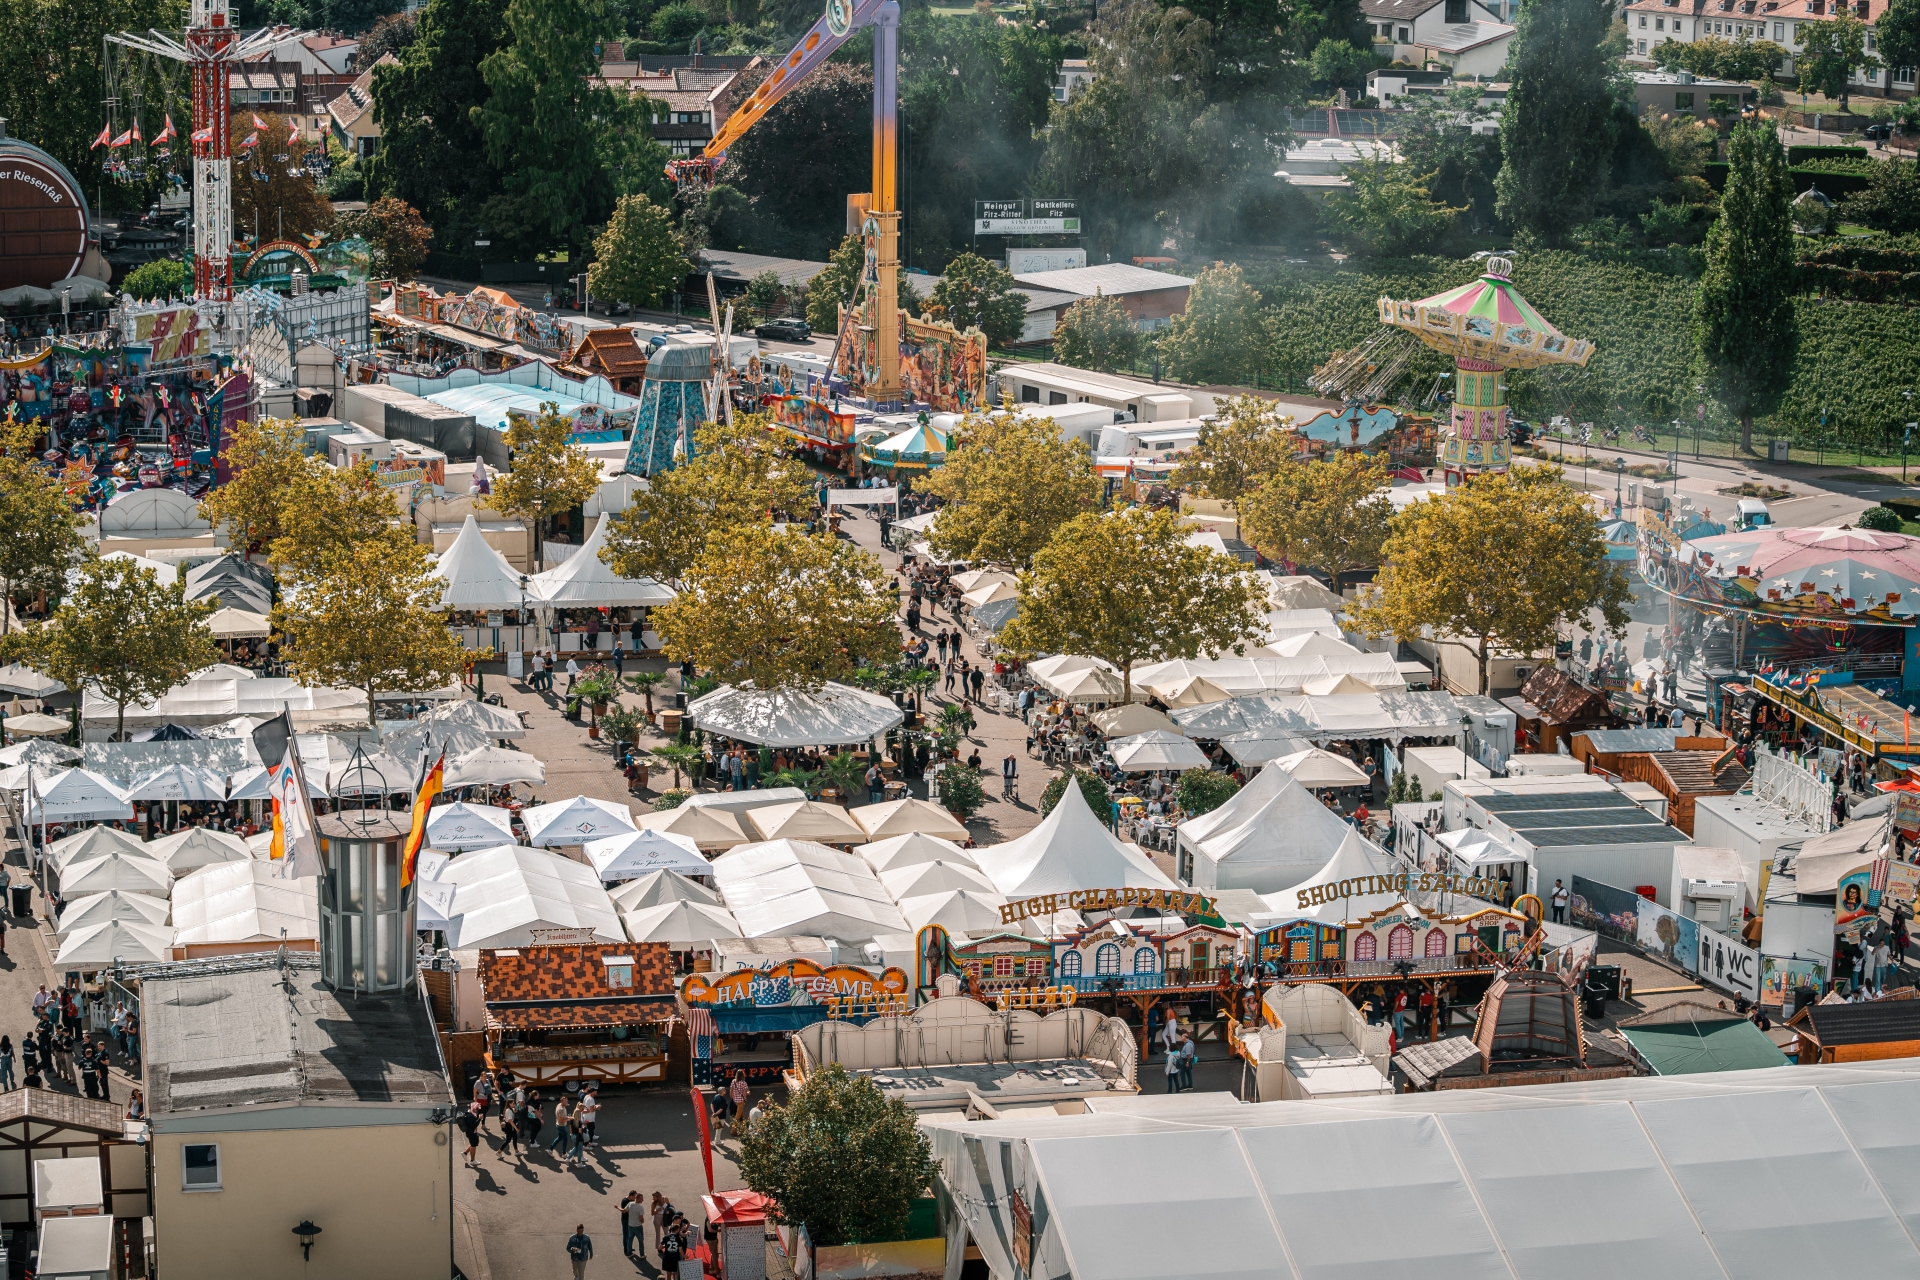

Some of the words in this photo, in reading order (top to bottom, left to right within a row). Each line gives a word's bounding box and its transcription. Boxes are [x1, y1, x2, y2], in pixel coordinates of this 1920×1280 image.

[13, 169, 63, 203] Riesenfaß
[983, 202, 1016, 210] Weingut
[1785, 696, 1799, 711] Die
[1799, 706, 1840, 734] Eisenbahn
[1404, 824, 1415, 853] WC
[1296, 872, 1508, 909] SHOOTING-SALOON
[998, 887, 1220, 925] HIGH-CHAPPARAL
[1372, 914, 1403, 931] PIONEER
[1475, 914, 1503, 922] BARBER
[1080, 931, 1103, 950] BANK
[1286, 927, 1302, 937] TOWN
[1302, 926, 1314, 936] JAIL
[1727, 946, 1752, 979] WC
[716, 977, 782, 1004] HAPPY
[812, 976, 874, 998] GAME
[1774, 970, 1812, 988] BEACH
[667, 1241, 679, 1251] 23
